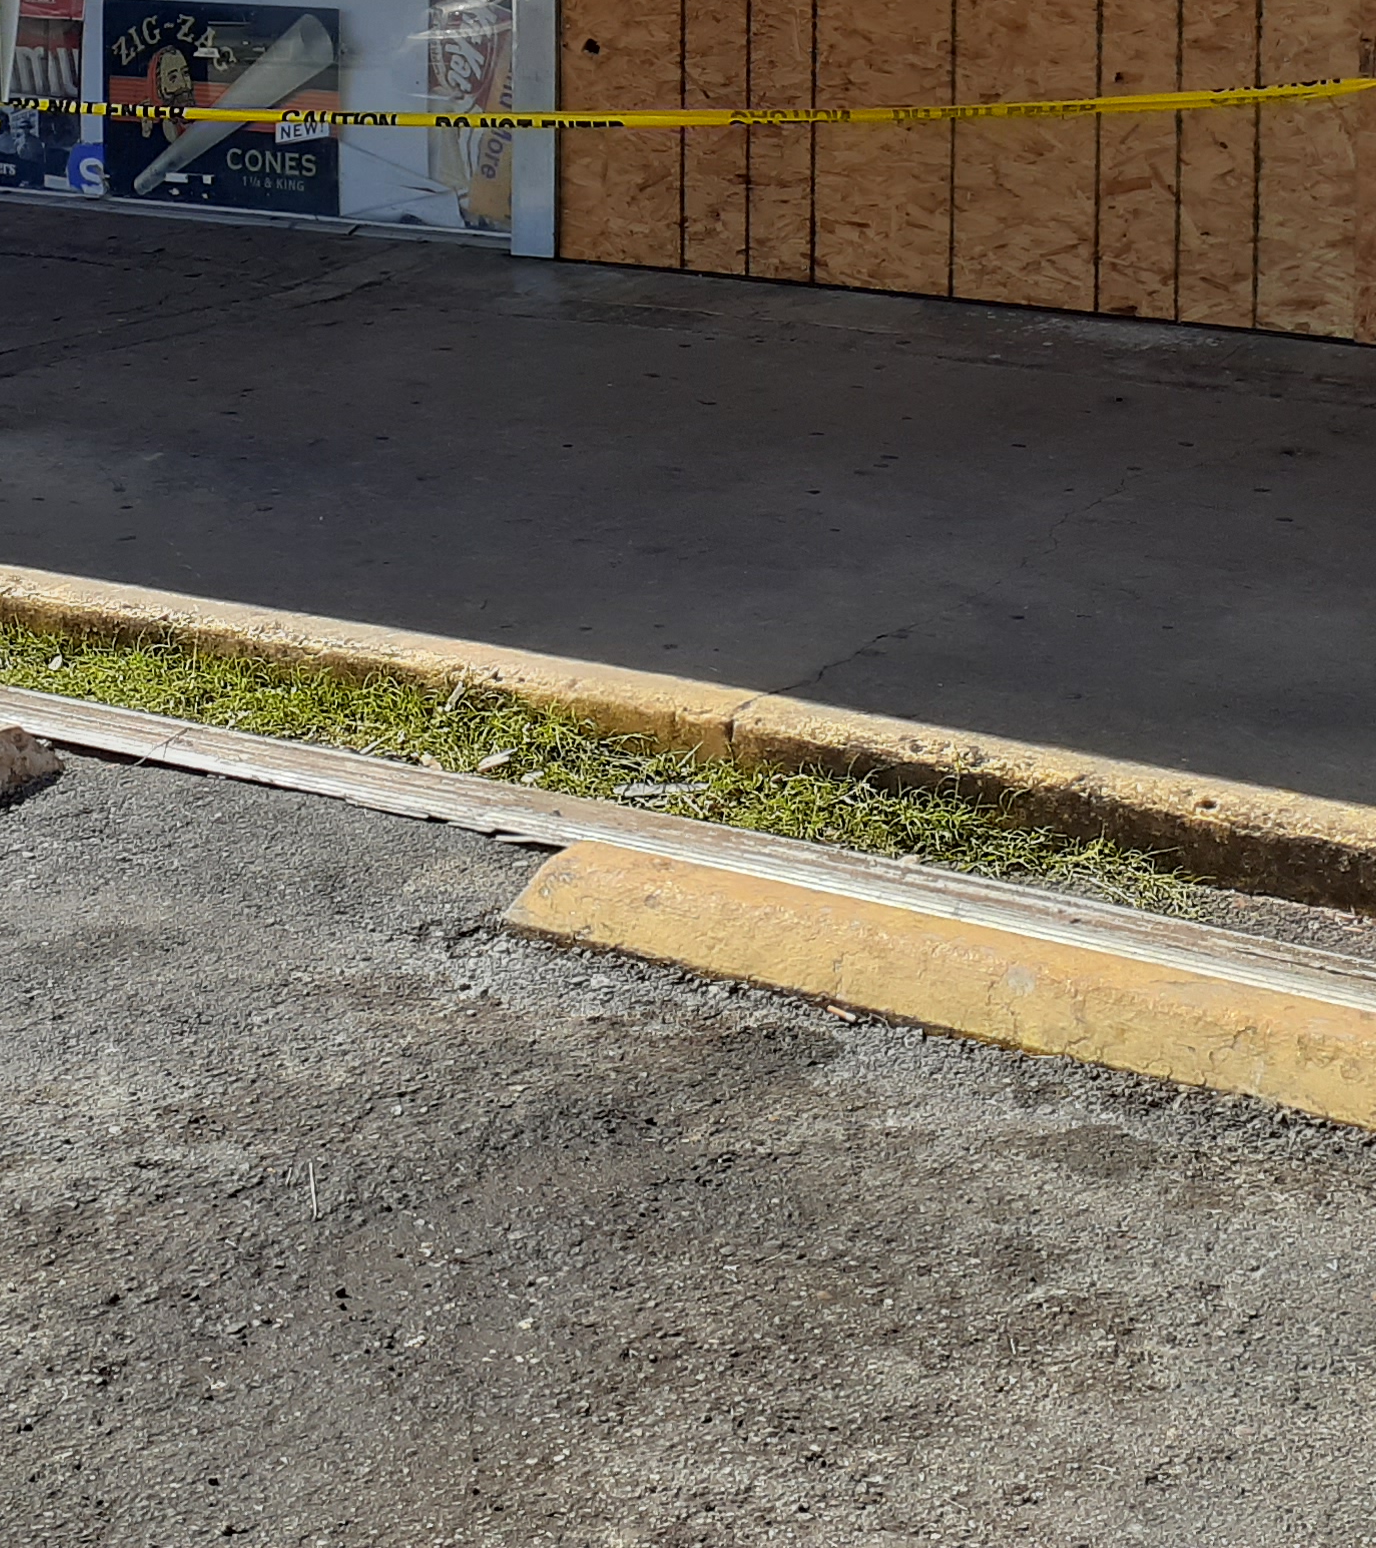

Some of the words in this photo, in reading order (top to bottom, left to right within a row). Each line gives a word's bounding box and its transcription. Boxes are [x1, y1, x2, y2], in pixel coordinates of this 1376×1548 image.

[110, 14, 239, 71] ZIG-ZAG
[280, 121, 328, 140] NEW!
[225, 148, 316, 177] CONES
[264, 177, 271, 190] &
[274, 178, 305, 192] KING
